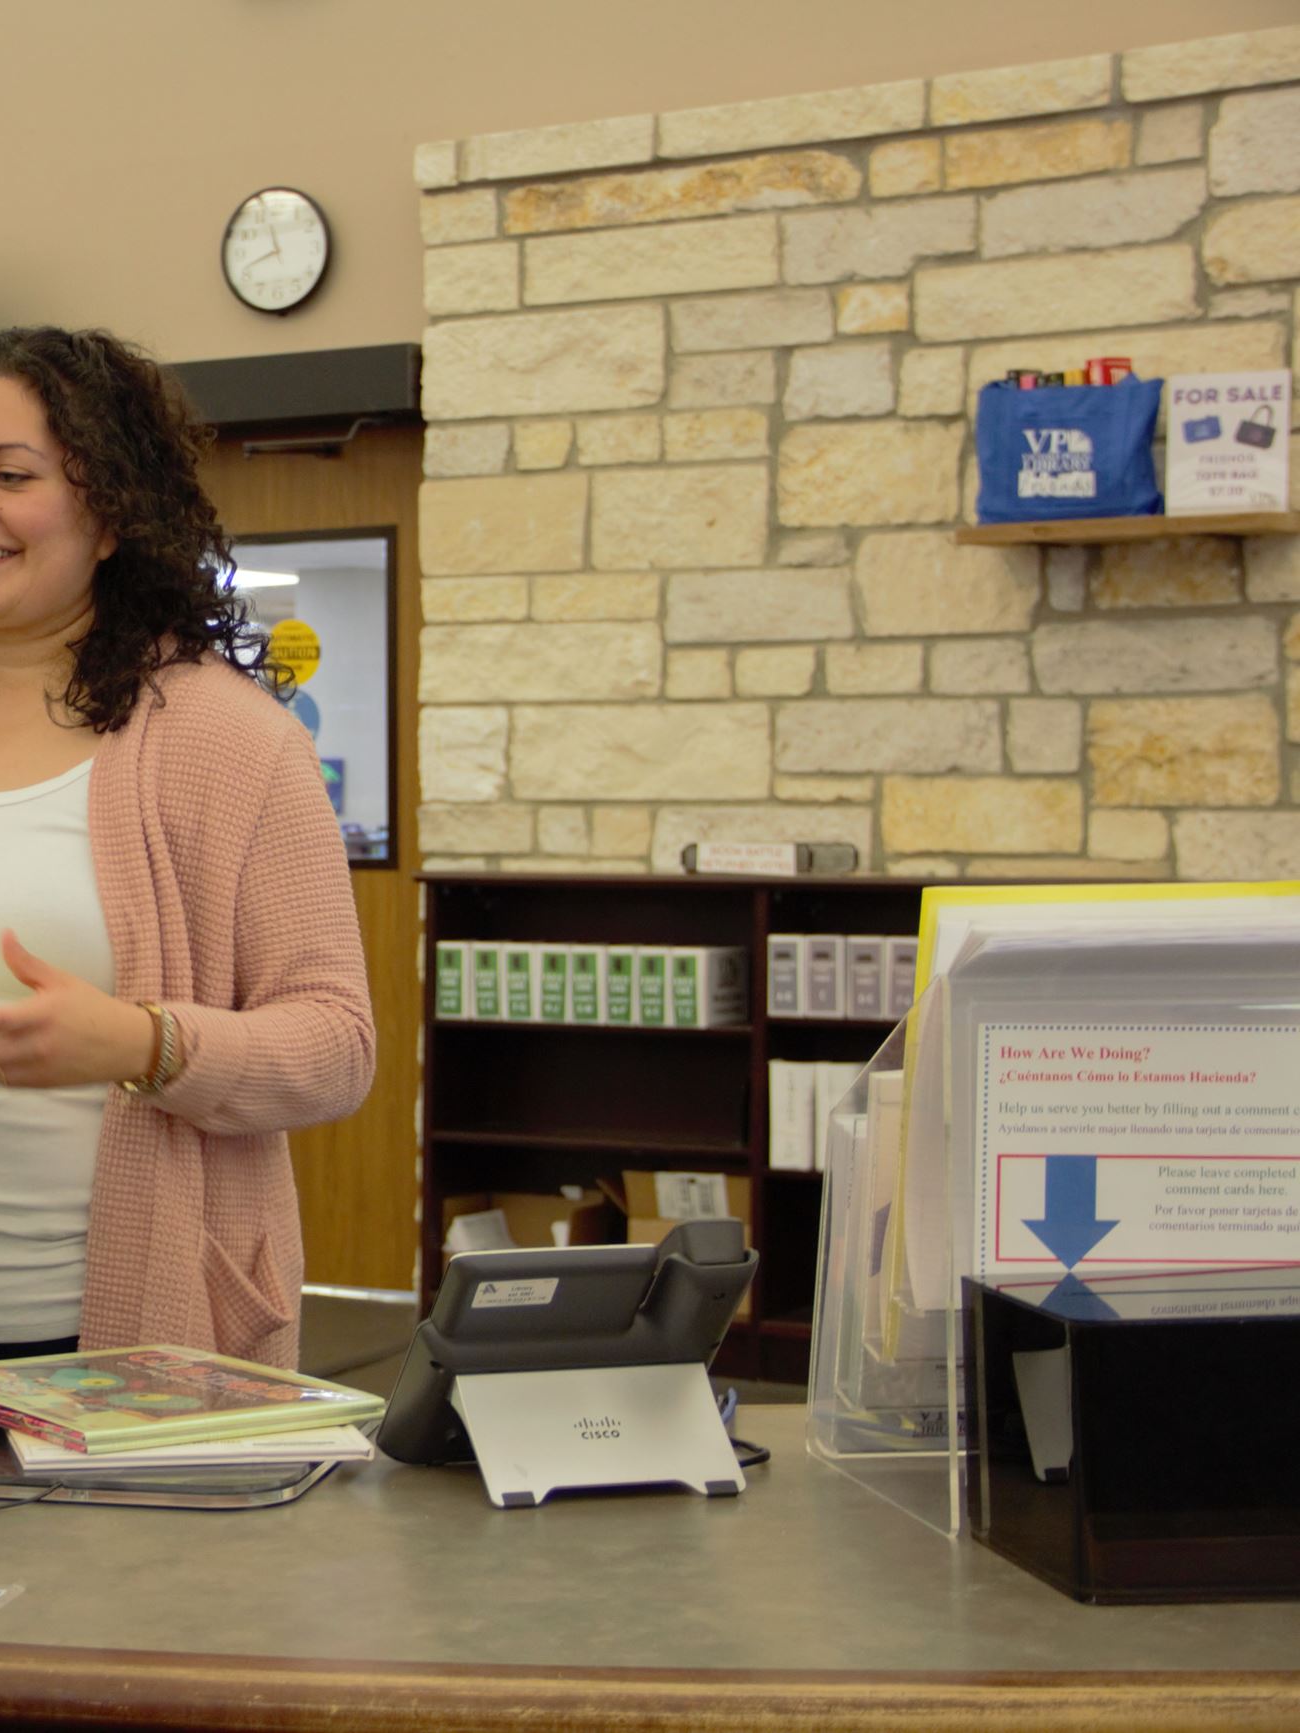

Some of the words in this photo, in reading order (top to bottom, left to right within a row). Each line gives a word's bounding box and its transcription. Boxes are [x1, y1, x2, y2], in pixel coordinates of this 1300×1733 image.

[1174, 387, 1218, 405] FOR
[1227, 384, 1282, 402] SALE
[1000, 1046, 1032, 1059] How
[1039, 1047, 1065, 1059] Are
[1071, 1047, 1094, 1059] We
[1100, 1047, 1150, 1062] Doing?
[1118, 1071, 1129, 1081] lo
[1134, 1071, 1185, 1082] Estamos
[1189, 1071, 1256, 1083] Hacienda?
[999, 1102, 1027, 1116] Help
[1031, 1105, 1043, 1114] us
[1047, 1104, 1078, 1114] serve
[1082, 1105, 1104, 1116] you
[1107, 1102, 1140, 1114] better
[1145, 1103, 1159, 1117] by
[1163, 1102, 1198, 1117] filling
[1202, 1104, 1221, 1115] out
[1224, 1106, 1231, 1115] a
[1235, 1105, 1290, 1115] comment
[1059, 1124, 1095, 1134] servirle
[1098, 1124, 1127, 1136] major
[1130, 1124, 1172, 1134] llenando
[1175, 1126, 1193, 1134] una
[1196, 1125, 1227, 1136] tarjeta
[1229, 1125, 1241, 1135] de
[1158, 1166, 1196, 1178] Please
[1200, 1166, 1230, 1178] leave
[1233, 1167, 1296, 1181] completed
[1165, 1184, 1220, 1195] comment
[1223, 1184, 1255, 1195] cards
[1258, 1184, 1288, 1195] here.
[1155, 1204, 1173, 1215] Por
[1177, 1204, 1206, 1215] favor
[1209, 1206, 1239, 1218] poner
[1242, 1205, 1282, 1218] tarjetas
[1286, 1205, 1298, 1216] de
[1149, 1220, 1216, 1231] comentarios
[1218, 1221, 1273, 1232] terminado
